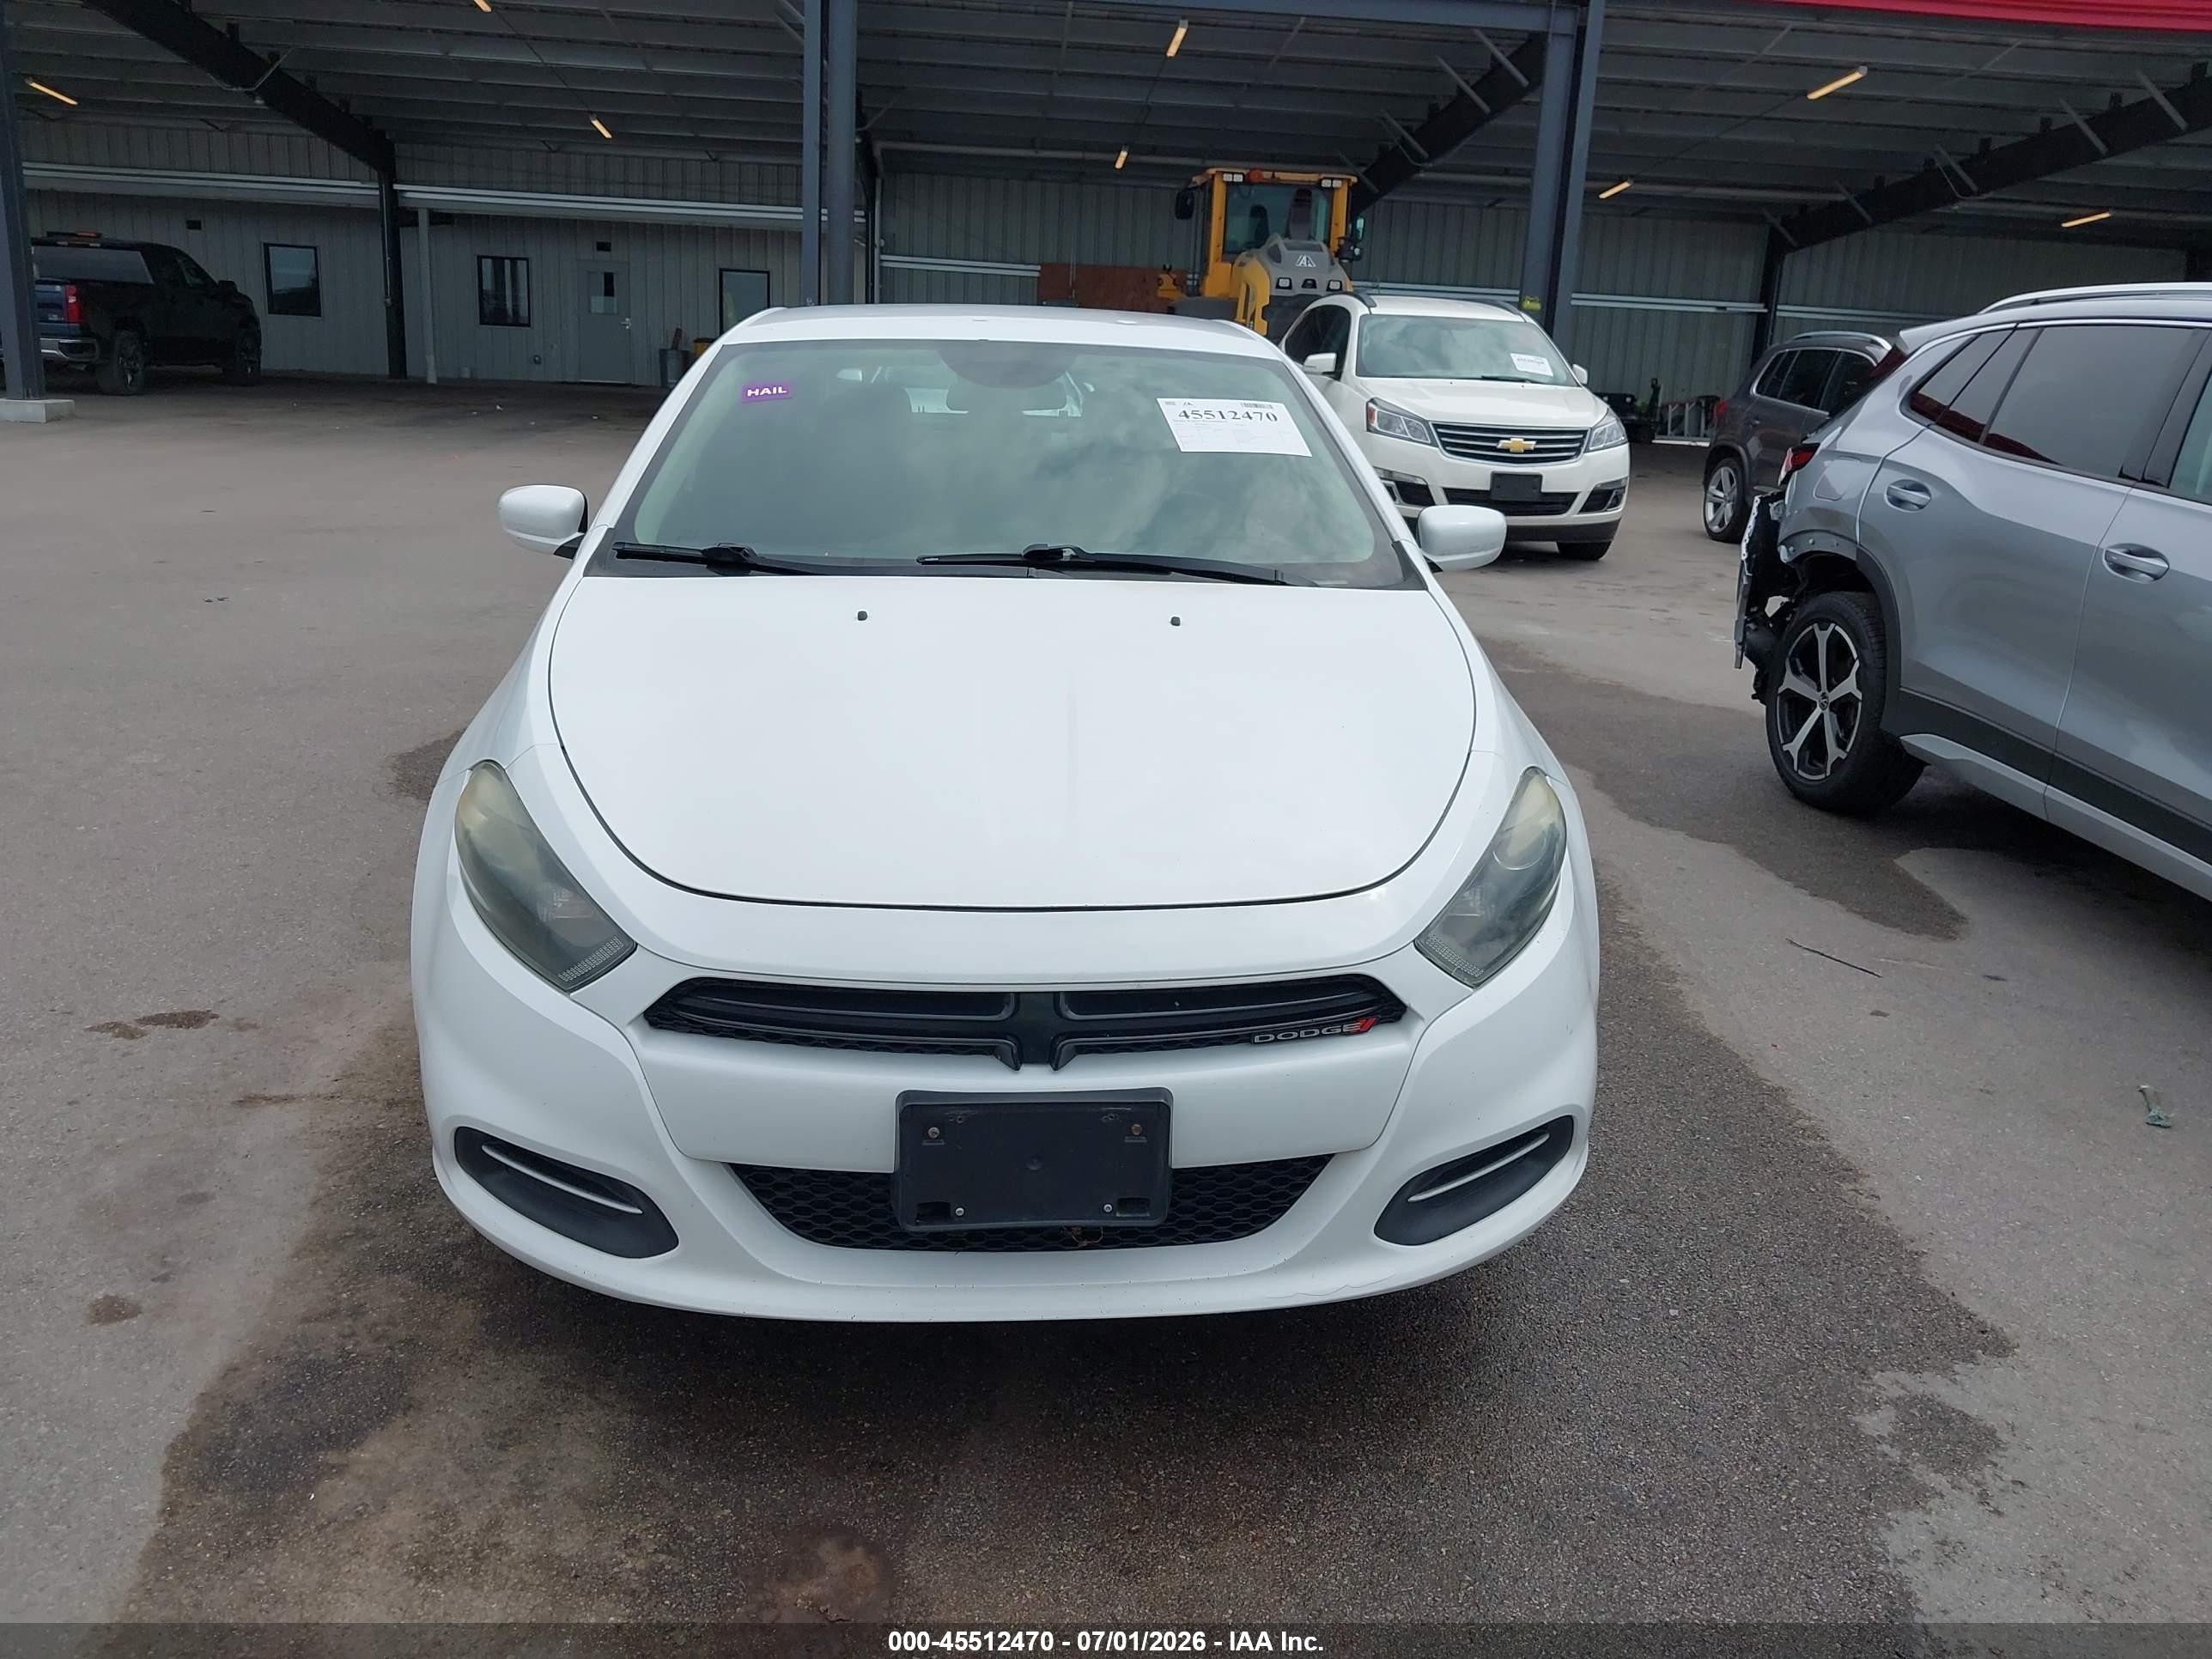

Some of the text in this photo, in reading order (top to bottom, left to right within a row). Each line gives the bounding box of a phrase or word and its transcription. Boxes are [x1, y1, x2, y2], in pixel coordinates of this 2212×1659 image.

[746, 386, 787, 397] HAIL
[1178, 410, 1279, 422] 45512470
[1254, 1022, 1361, 1043] DODGE
